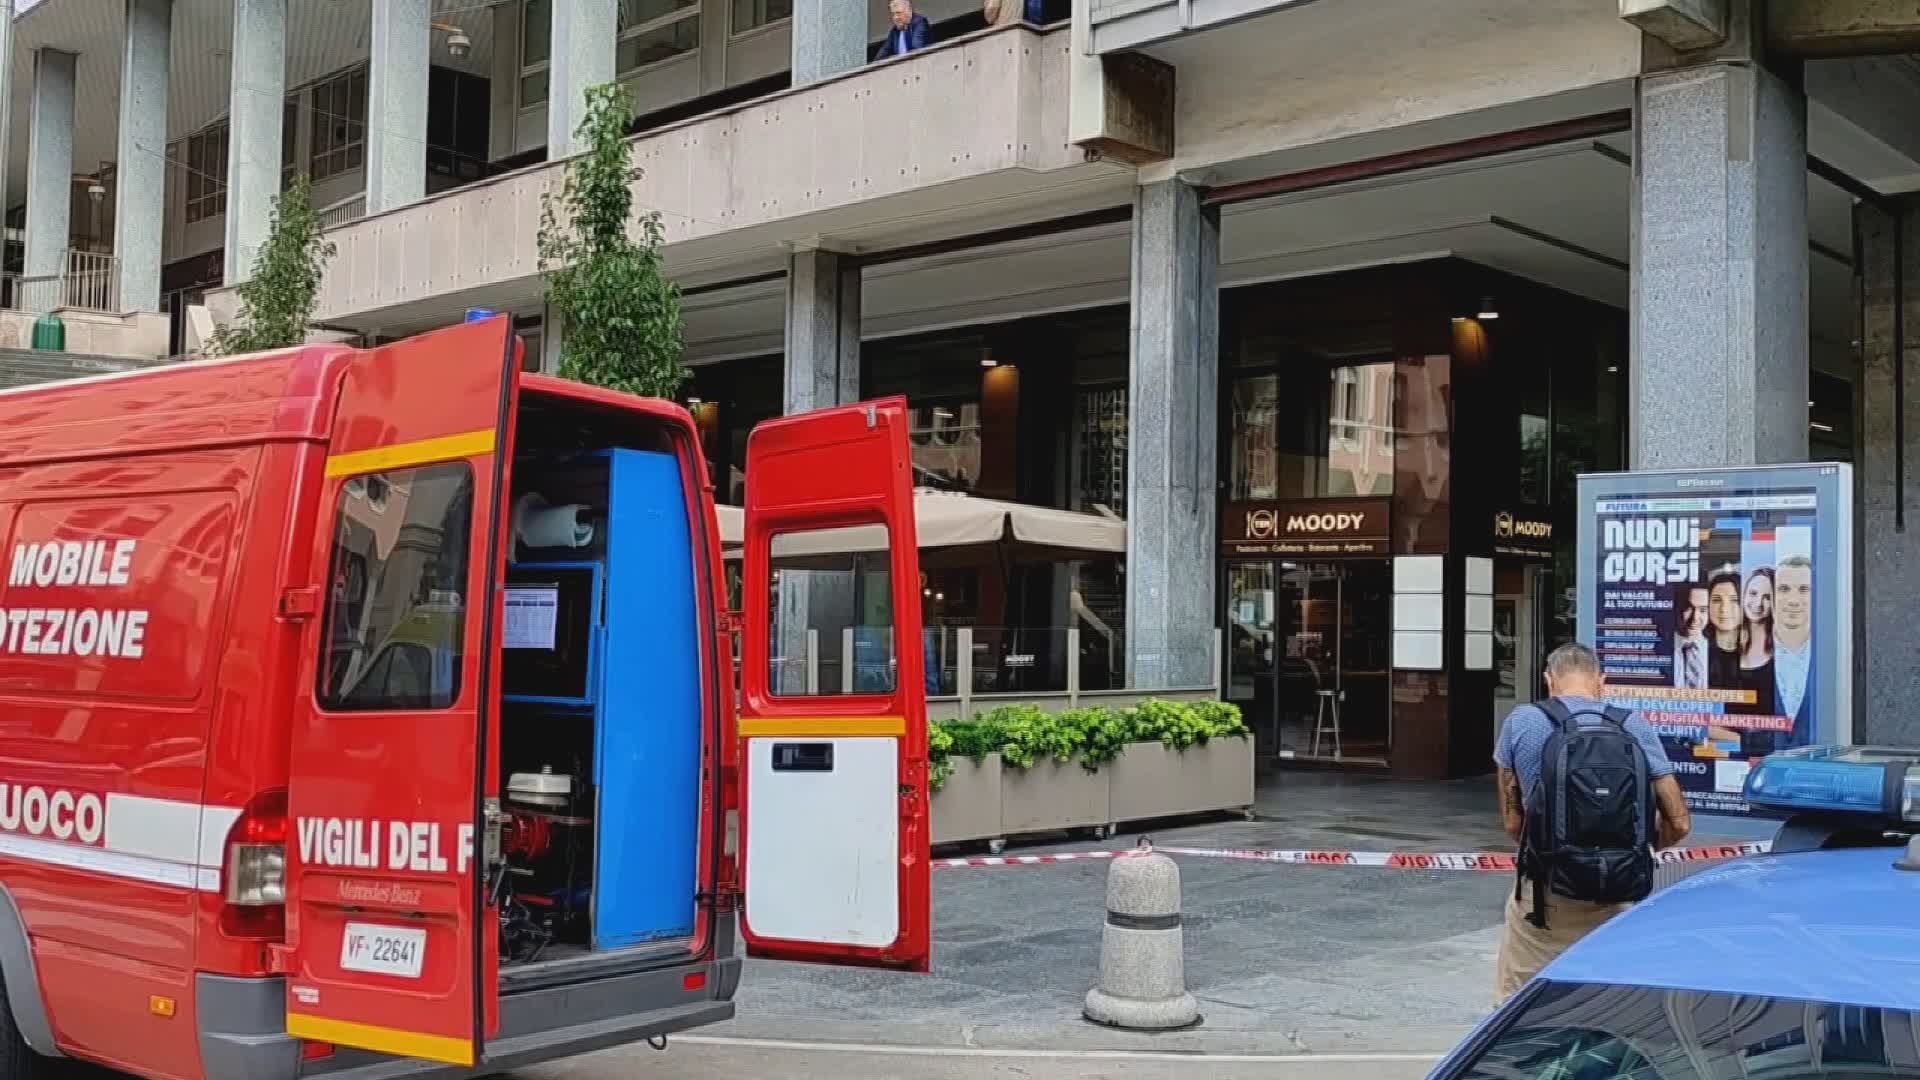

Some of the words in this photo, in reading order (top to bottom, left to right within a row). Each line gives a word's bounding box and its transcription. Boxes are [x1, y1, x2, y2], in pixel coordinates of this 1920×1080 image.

[1286, 512, 1364, 532] MOODY
[1515, 520, 1552, 538] MOODY
[8, 540, 136, 587] MOBILE
[1603, 686, 1670, 699] SOFTWARE
[1672, 689, 1744, 702] DEVELOPER
[1643, 700, 1714, 712] DEVELOPER
[1659, 713, 1707, 725] DIGITAL
[1709, 715, 1786, 729] MARKETING
[297, 816, 379, 869] VIGILI
[388, 821, 448, 872] DEL
[1393, 855, 1456, 867] VIGILI
[1462, 856, 1510, 868] DEL
[373, 936, 417, 965] 22641
